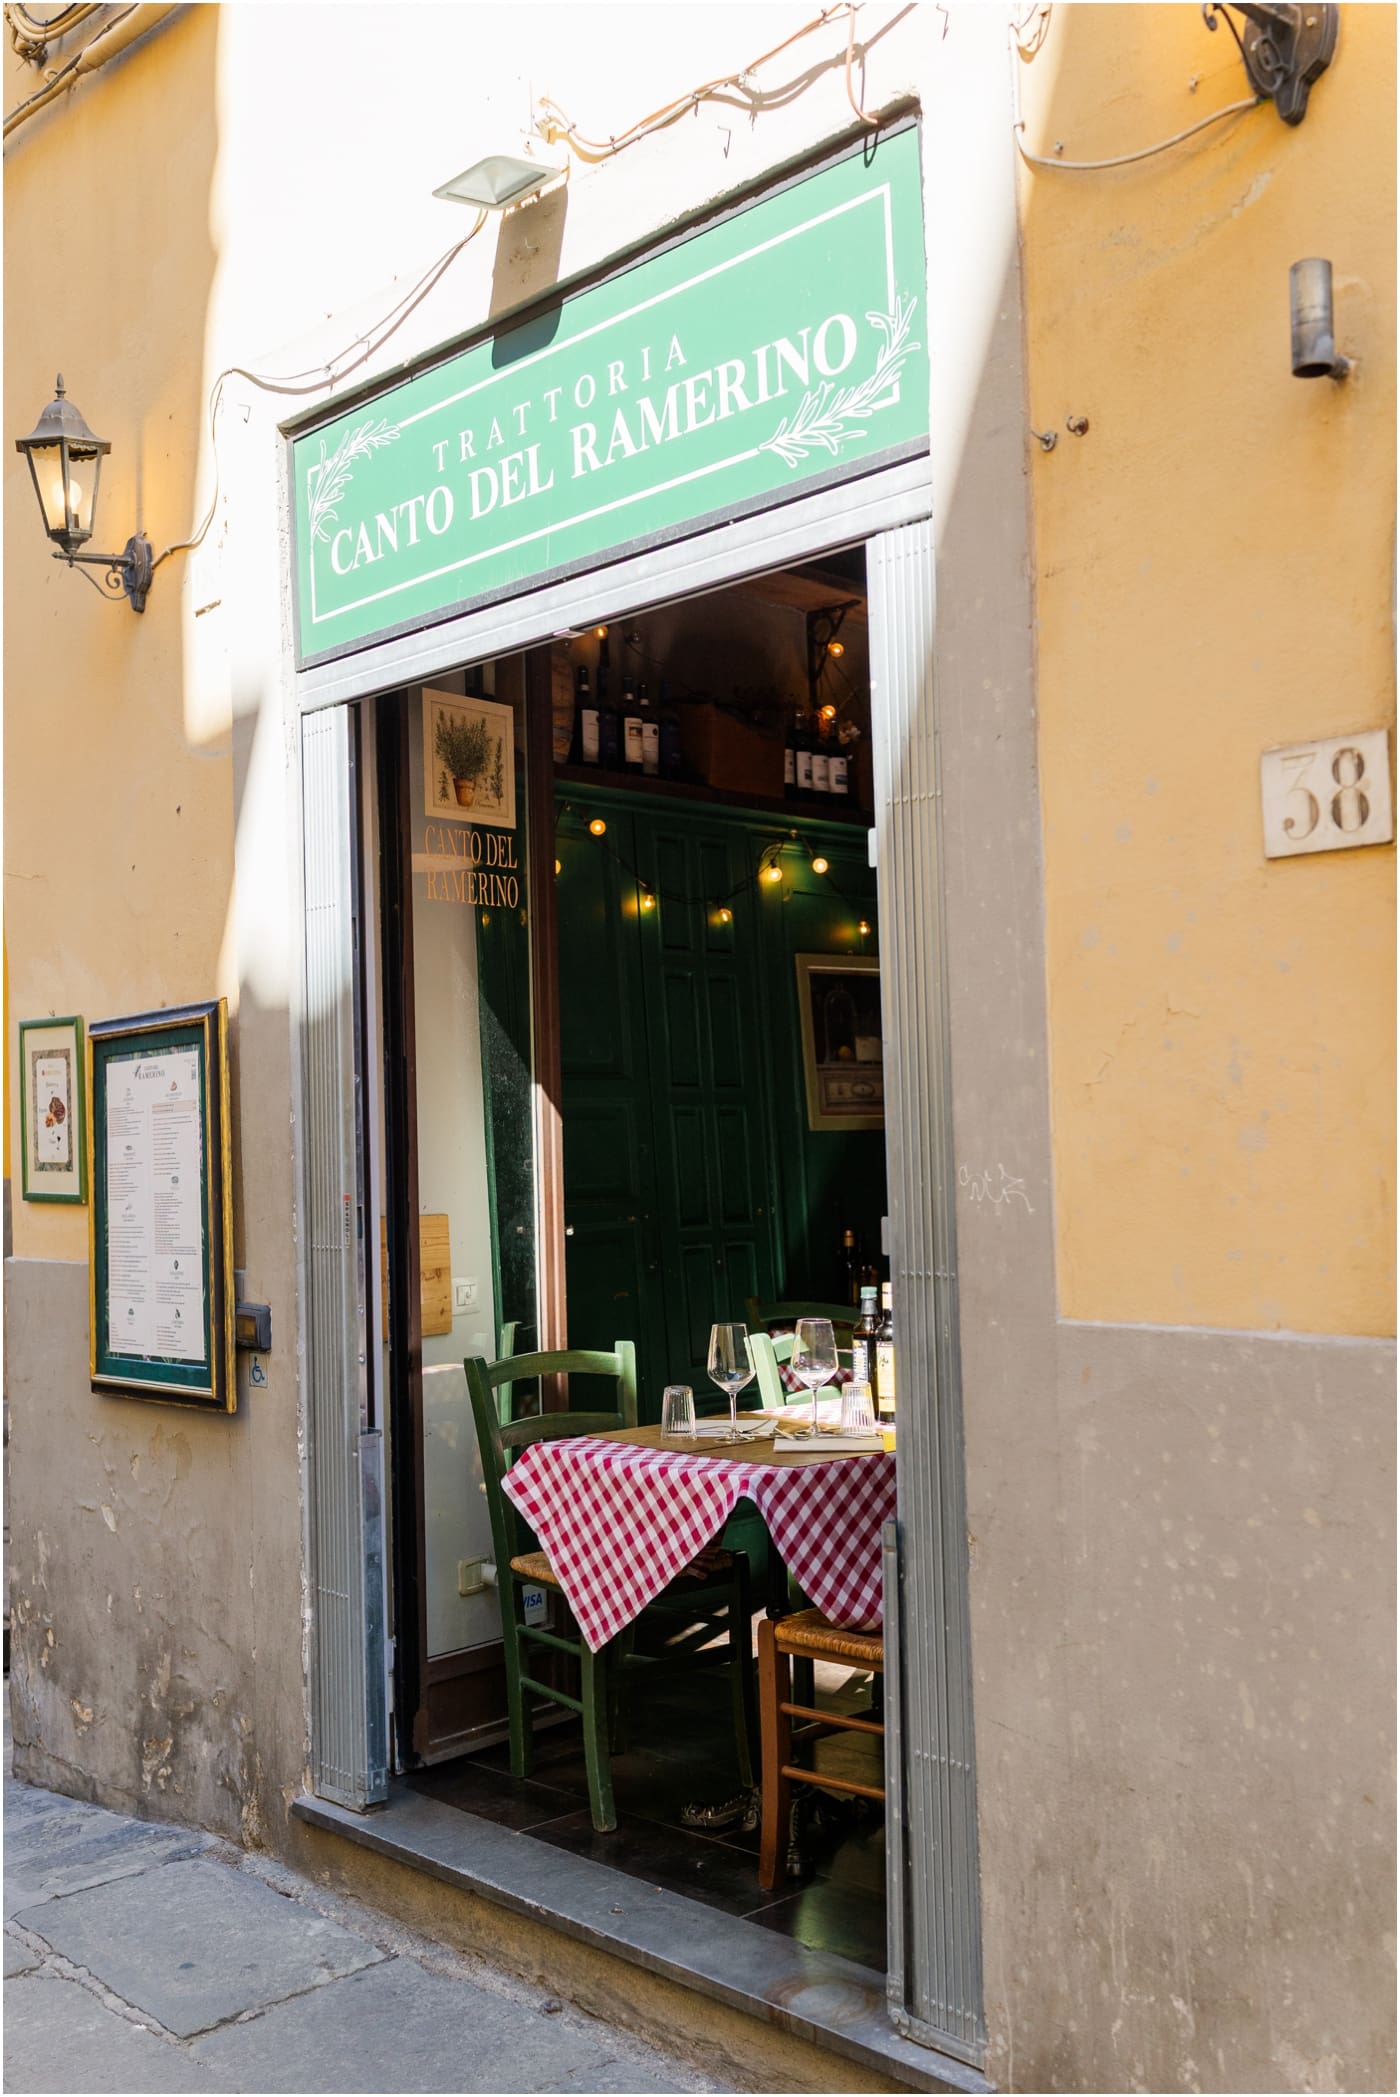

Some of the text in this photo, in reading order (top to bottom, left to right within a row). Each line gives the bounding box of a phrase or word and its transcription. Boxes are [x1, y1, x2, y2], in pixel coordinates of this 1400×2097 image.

[331, 313, 858, 575] CANTO DEL RAMERINO
[432, 335, 687, 472] TRATTORIA
[1280, 747, 1370, 840] 38
[424, 825, 518, 869] CANTO DEL
[426, 866, 519, 909] RAMERINO
